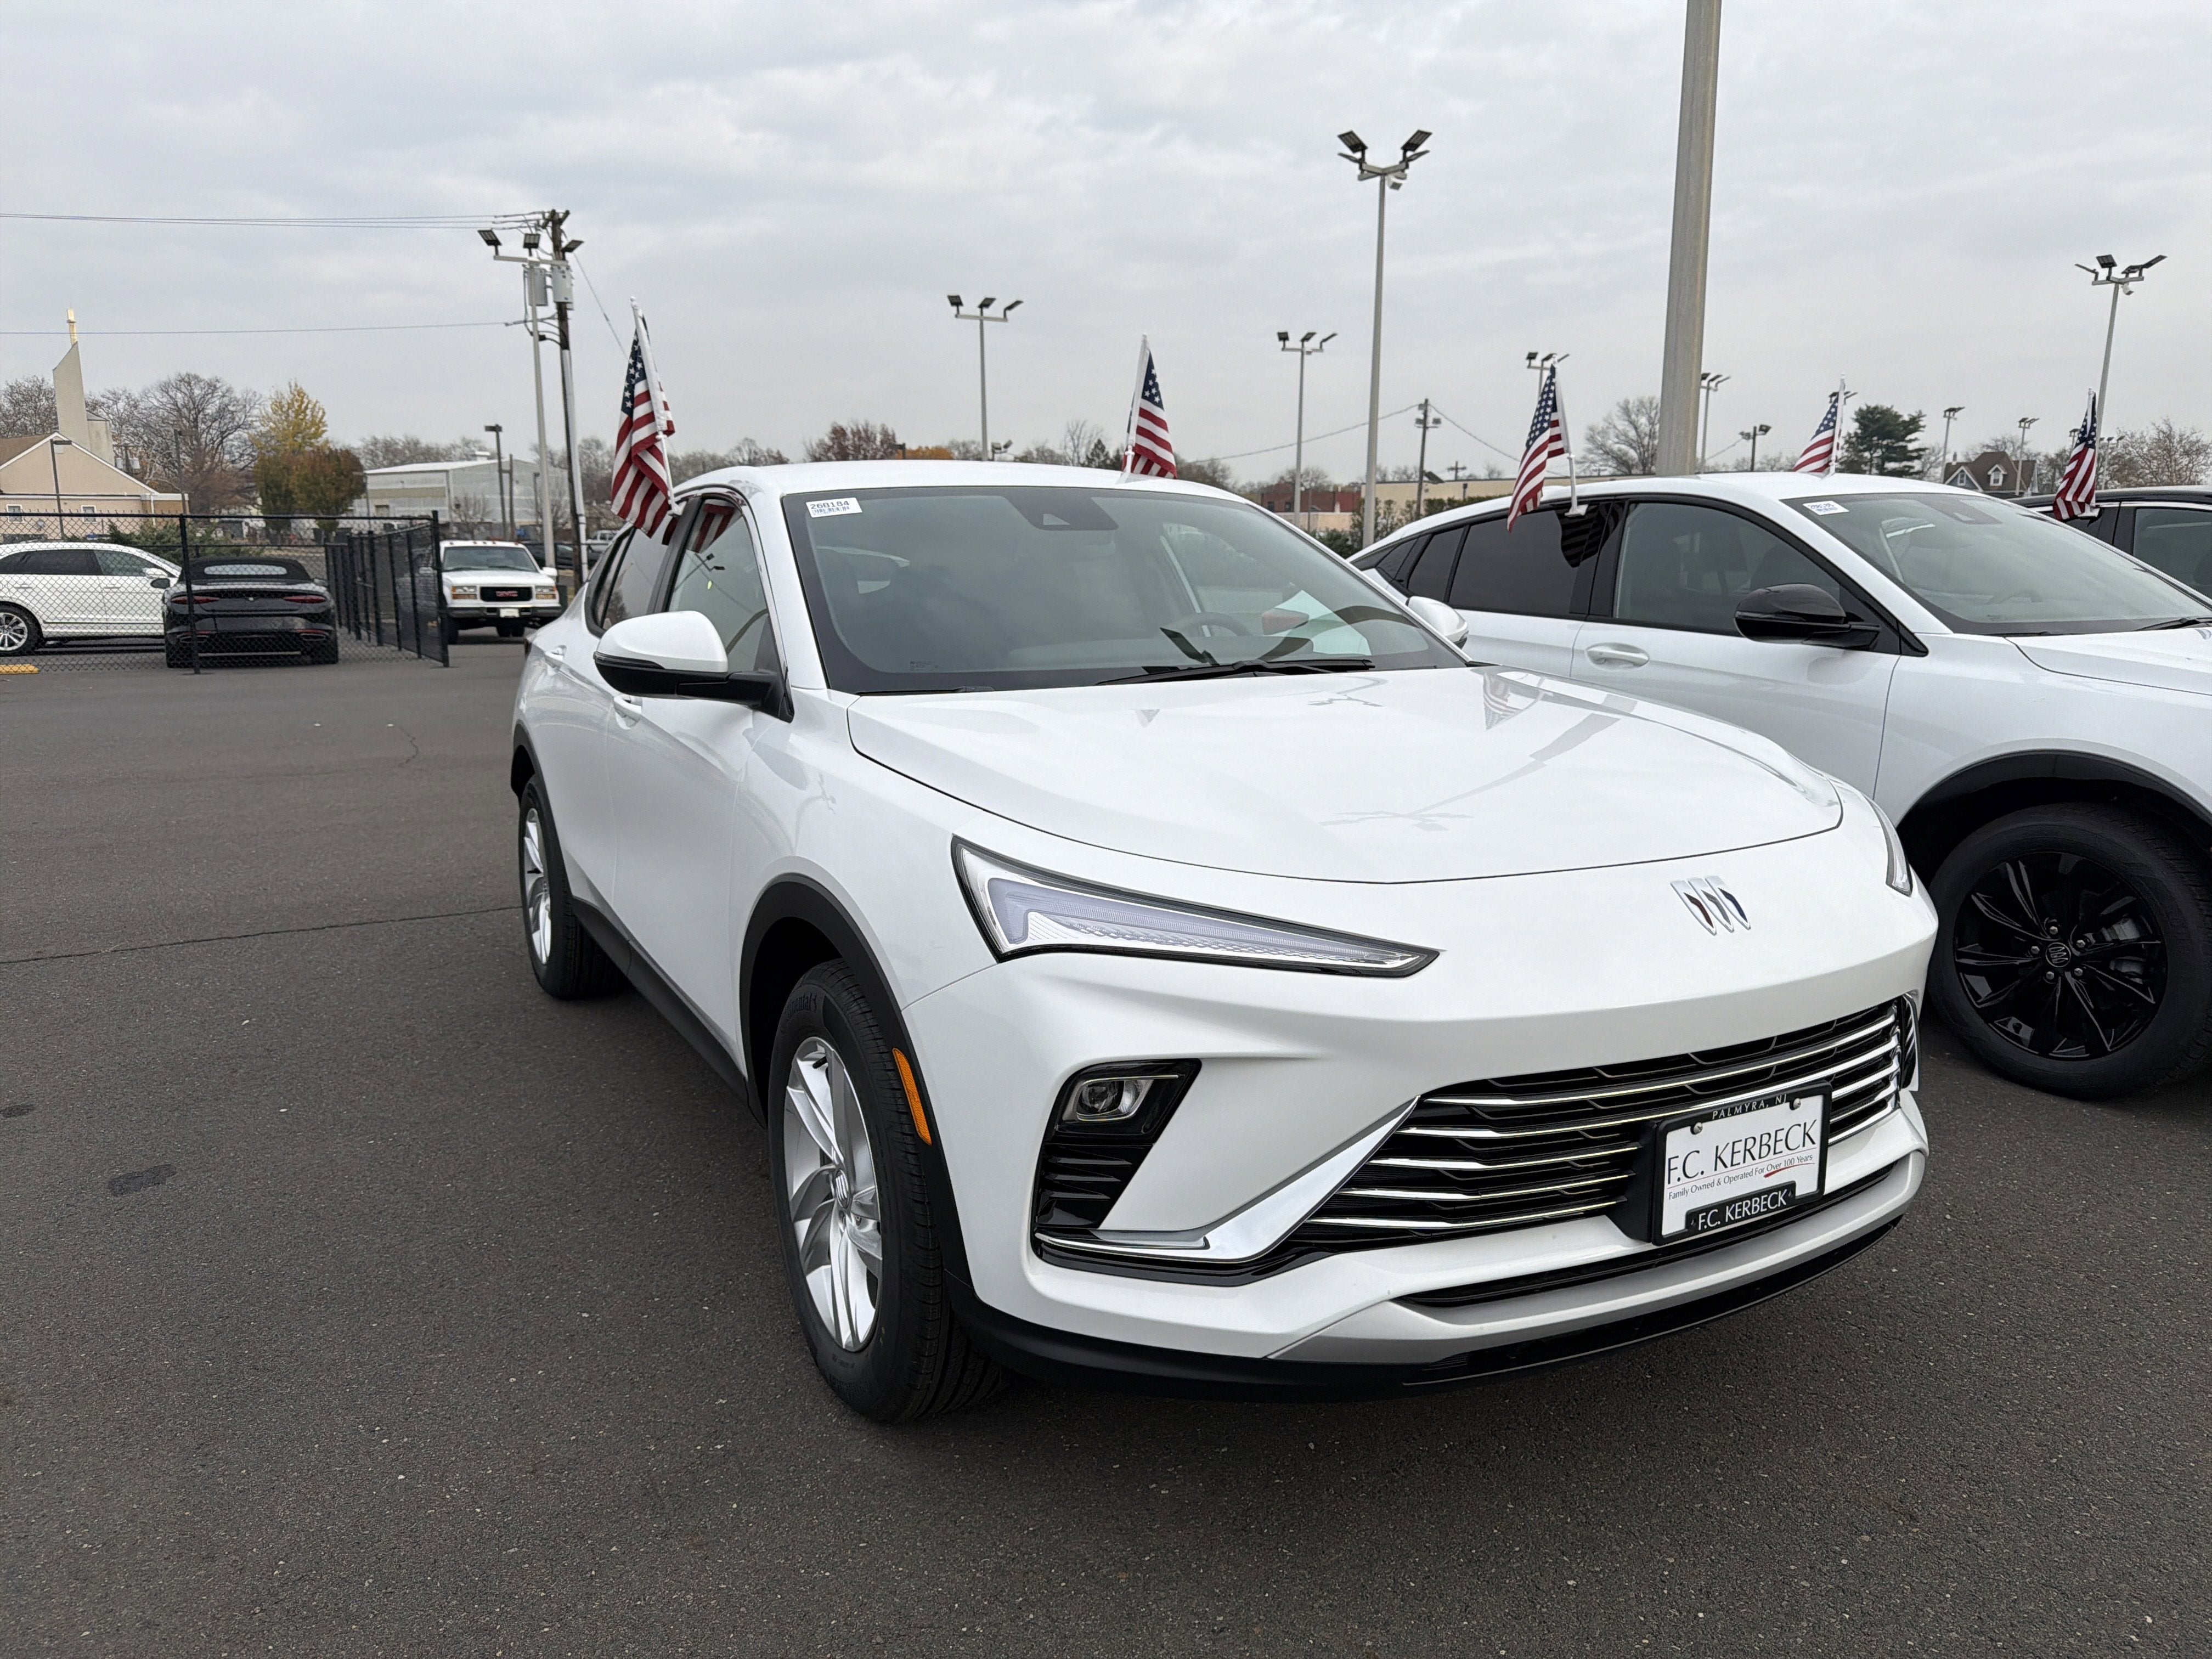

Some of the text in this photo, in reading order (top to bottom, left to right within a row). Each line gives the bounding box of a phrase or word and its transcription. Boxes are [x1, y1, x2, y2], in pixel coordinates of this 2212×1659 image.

[810, 500, 850, 509] 26B184
[1712, 1093, 1787, 1120] PALMYRA, NJ
[1667, 1119, 1818, 1185] F.C. KERBECK
[1668, 1154, 1813, 1200] Family Owned & Operated For Over 100 Years
[1698, 1189, 1788, 1231] F.C. KERBECK
